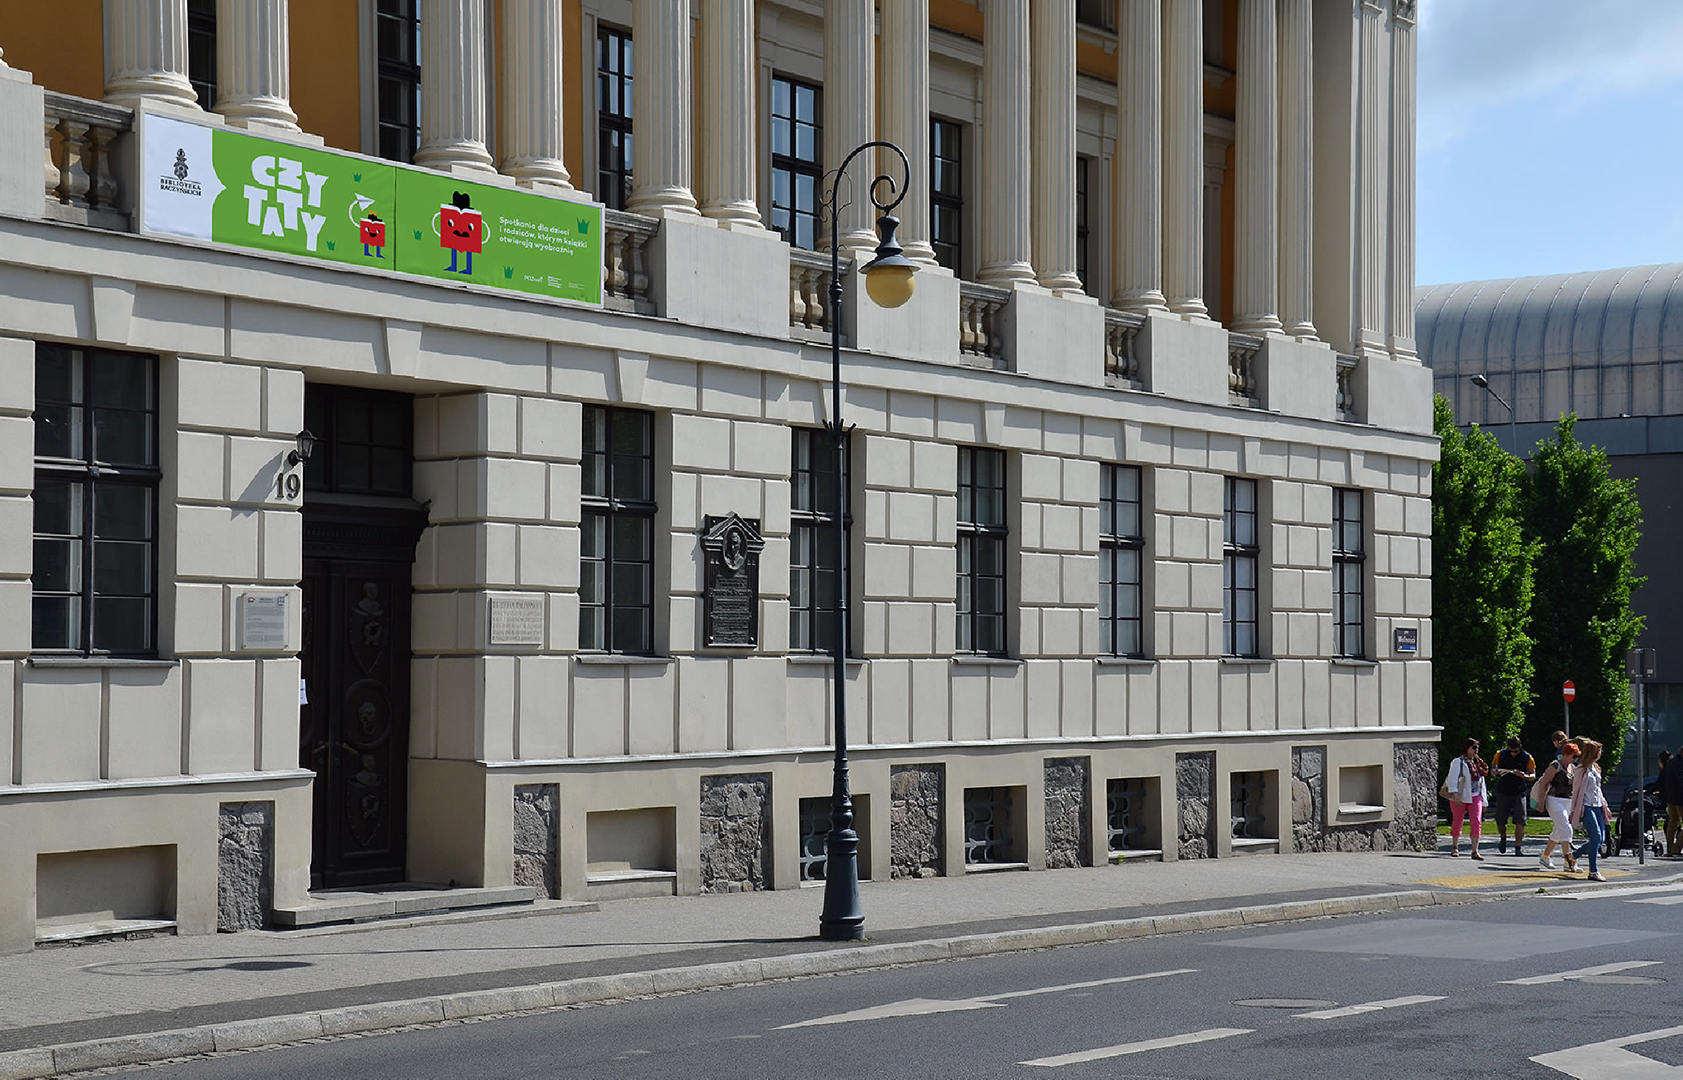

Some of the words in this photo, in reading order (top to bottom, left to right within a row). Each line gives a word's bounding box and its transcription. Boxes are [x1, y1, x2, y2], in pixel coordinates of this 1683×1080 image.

[160, 179, 201, 190] BIBLIOTEKA
[538, 223, 549, 232] dla
[550, 226, 570, 237] dzieci
[538, 232, 563, 244] którym
[276, 473, 300, 499] 19
